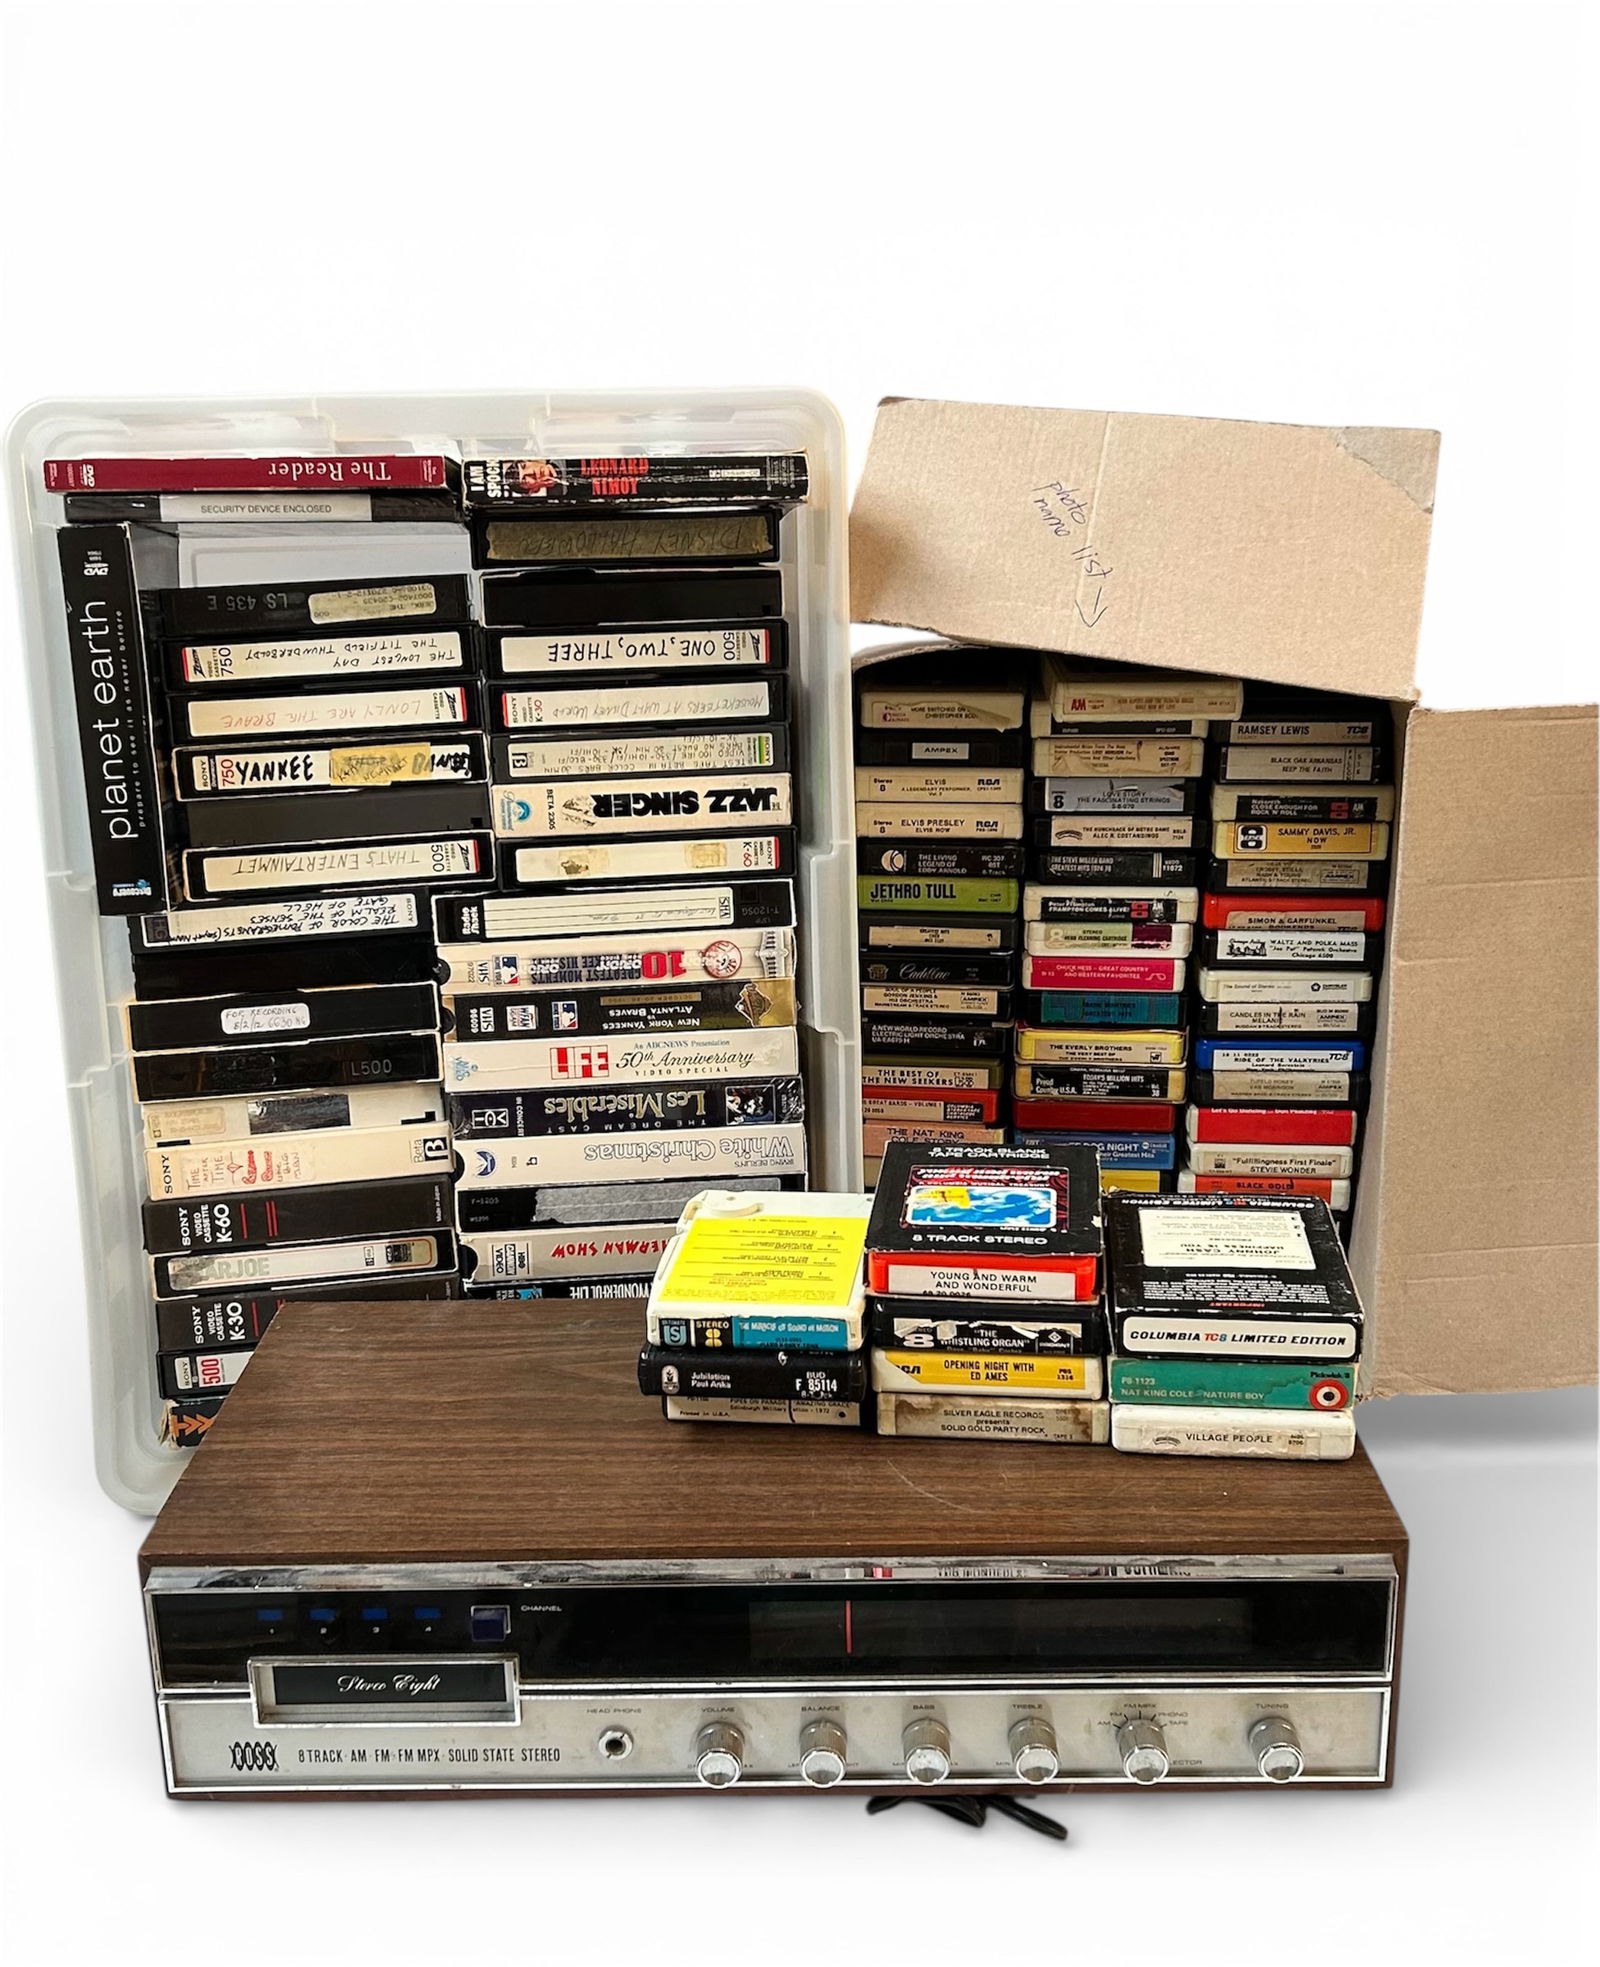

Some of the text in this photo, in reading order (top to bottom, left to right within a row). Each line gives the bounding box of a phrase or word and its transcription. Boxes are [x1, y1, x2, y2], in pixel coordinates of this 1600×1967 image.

[268, 462, 391, 481] The Reader
[581, 458, 648, 477] LEONARD
[592, 477, 638, 496] NIMOY
[200, 504, 332, 514] SECURITY DEVICE ENCLOSED
[1032, 481, 1087, 525] photo
[1033, 498, 1070, 537] name
[1071, 545, 1113, 578] list
[429, 650, 456, 664] THE
[547, 640, 614, 662] THREE
[220, 647, 235, 676] 750
[371, 652, 420, 667] LONGEST
[329, 706, 356, 721] ARE
[363, 699, 421, 720] LONLY
[79, 601, 139, 838] planet earth
[220, 711, 276, 729] BRAVE
[1238, 726, 1310, 735] RAMSEY LEWIS
[924, 746, 959, 754] AMPEX
[220, 758, 236, 787] 750
[235, 754, 314, 785] YANKEE
[590, 787, 778, 819] JAZZ SINGER
[901, 819, 965, 827] ELVIS PRESLEY
[1278, 828, 1310, 836] SAMMY
[1313, 828, 1340, 837] DAVIS,
[870, 883, 957, 899] JETHRO TULL
[284, 902, 324, 912] HELL
[330, 900, 346, 910] OF
[641, 951, 687, 980] 10
[609, 1005, 694, 1017] ATLANTA BRAVES
[602, 1018, 700, 1031] NEW YORK YANKEES
[552, 1045, 608, 1079] LIFE
[655, 1048, 754, 1069] Anniversary
[1329, 1052, 1349, 1061] TC8
[350, 1058, 392, 1078] L500
[878, 1069, 896, 1077] THE
[863, 1076, 953, 1087] THE NEW SEEKERS
[668, 1091, 706, 1115] Les
[584, 1137, 794, 1165] White Christmas
[1288, 1158, 1308, 1166] First
[1250, 1166, 1316, 1174] STEVIE WONDER
[1236, 1181, 1294, 1190] BLACK GOLD
[178, 1207, 191, 1247] SONY
[213, 1203, 233, 1243] K-60
[912, 1234, 1049, 1245] 8 TRACK STEREO
[551, 1239, 598, 1260] SHOW
[930, 1271, 1037, 1284] YOUNG AND WARM
[935, 1280, 1033, 1293] AND WONDERFUL
[992, 1339, 1031, 1349] ORGAN"
[1130, 1331, 1347, 1346] COLUMBIA TC8 LIMITED EDITION
[944, 1359, 1035, 1372] OPENING NIGHT WITH
[690, 1371, 731, 1381] Jubilation
[970, 1371, 1009, 1382] ED AMES
[690, 1380, 732, 1390] Paul Anka
[795, 1378, 838, 1392] F 85114
[1121, 1388, 1265, 1400] NAT KING COLE NATURE BOY
[943, 1409, 1044, 1419] SILVER EAGLE RECORDS
[941, 1423, 1045, 1435] SOLID GOLD PARTY ROCK
[976, 1419, 1010, 1427] presents
[1185, 1432, 1273, 1444] VILLAGE PEOPLE
[337, 1673, 441, 1697] Stereo Eight
[299, 1748, 561, 1763] 8 TRACK AM FM FM MPX SOLID STATE STEREO
